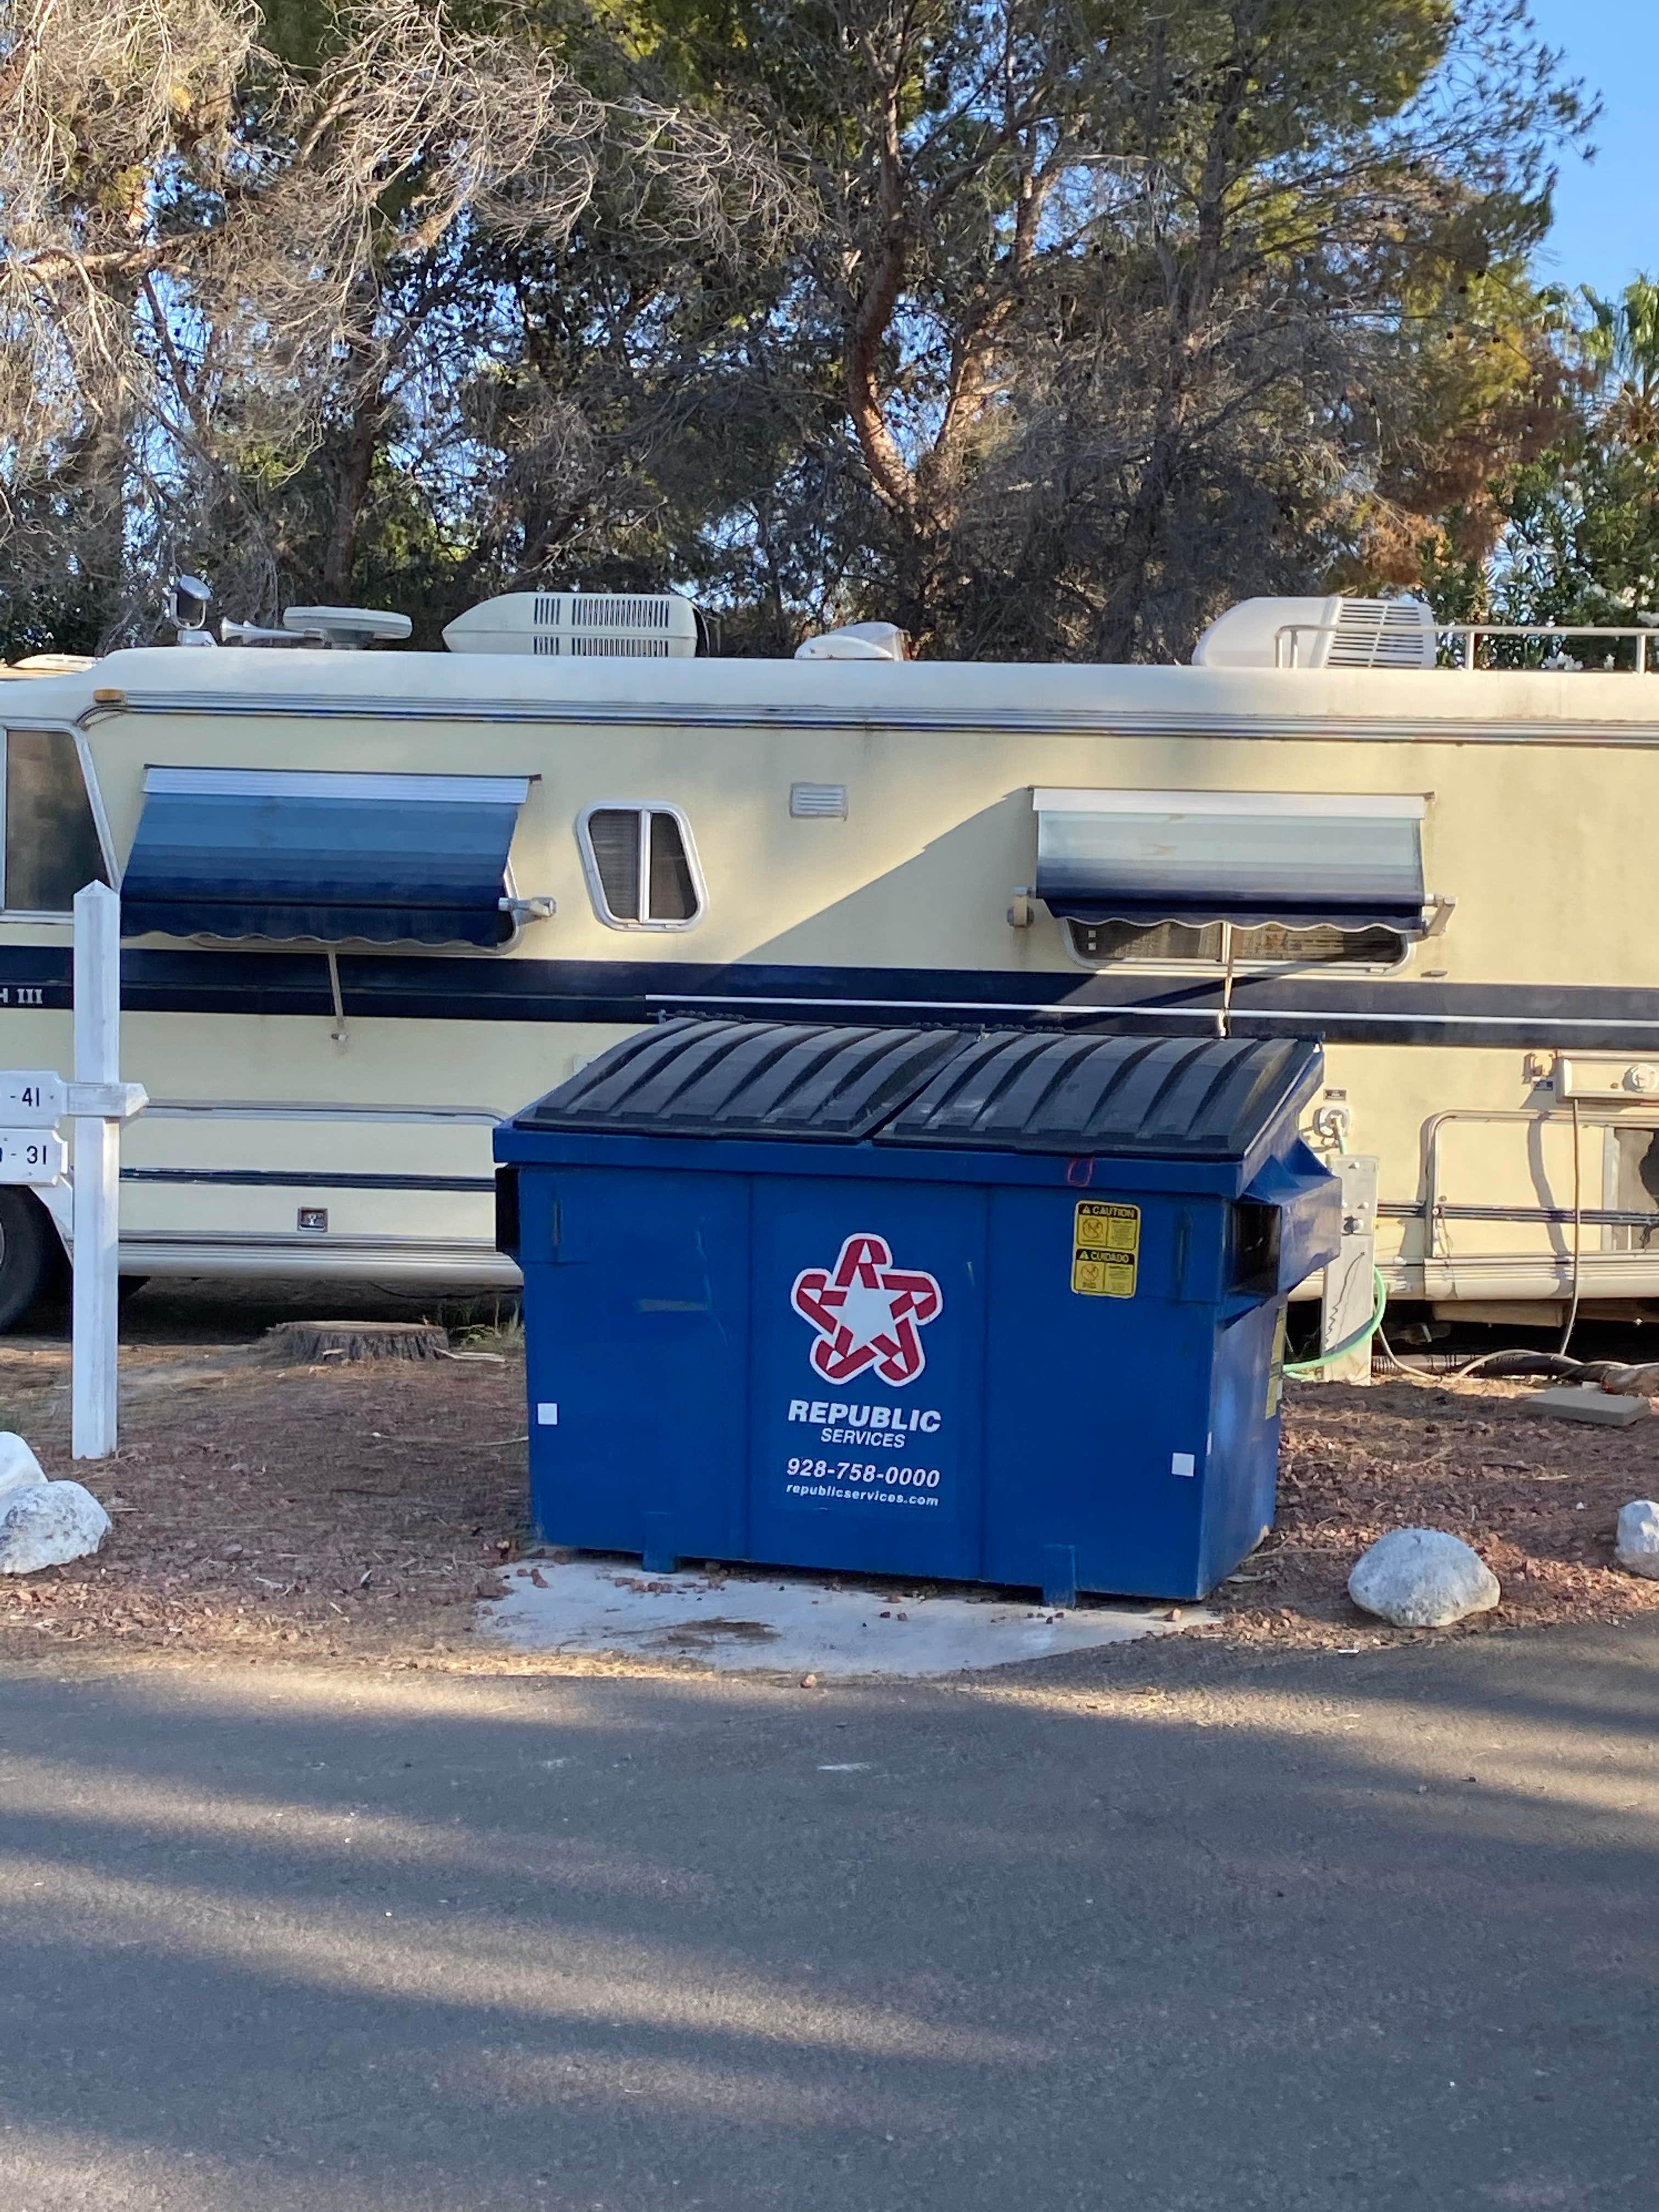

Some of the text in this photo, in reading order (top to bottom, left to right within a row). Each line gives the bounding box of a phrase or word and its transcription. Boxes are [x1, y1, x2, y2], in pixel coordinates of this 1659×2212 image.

[22, 1087, 40, 1107] 41
[27, 1146, 46, 1165] 31
[1092, 1206, 1135, 1217] CAUTION
[1091, 1251, 1129, 1262] CUIDADO
[788, 1400, 941, 1432] REPUBLIC
[821, 1428, 906, 1448] SERVICES
[787, 1458, 940, 1488] 928-758-0000
[786, 1484, 939, 1506] republicservices.com
